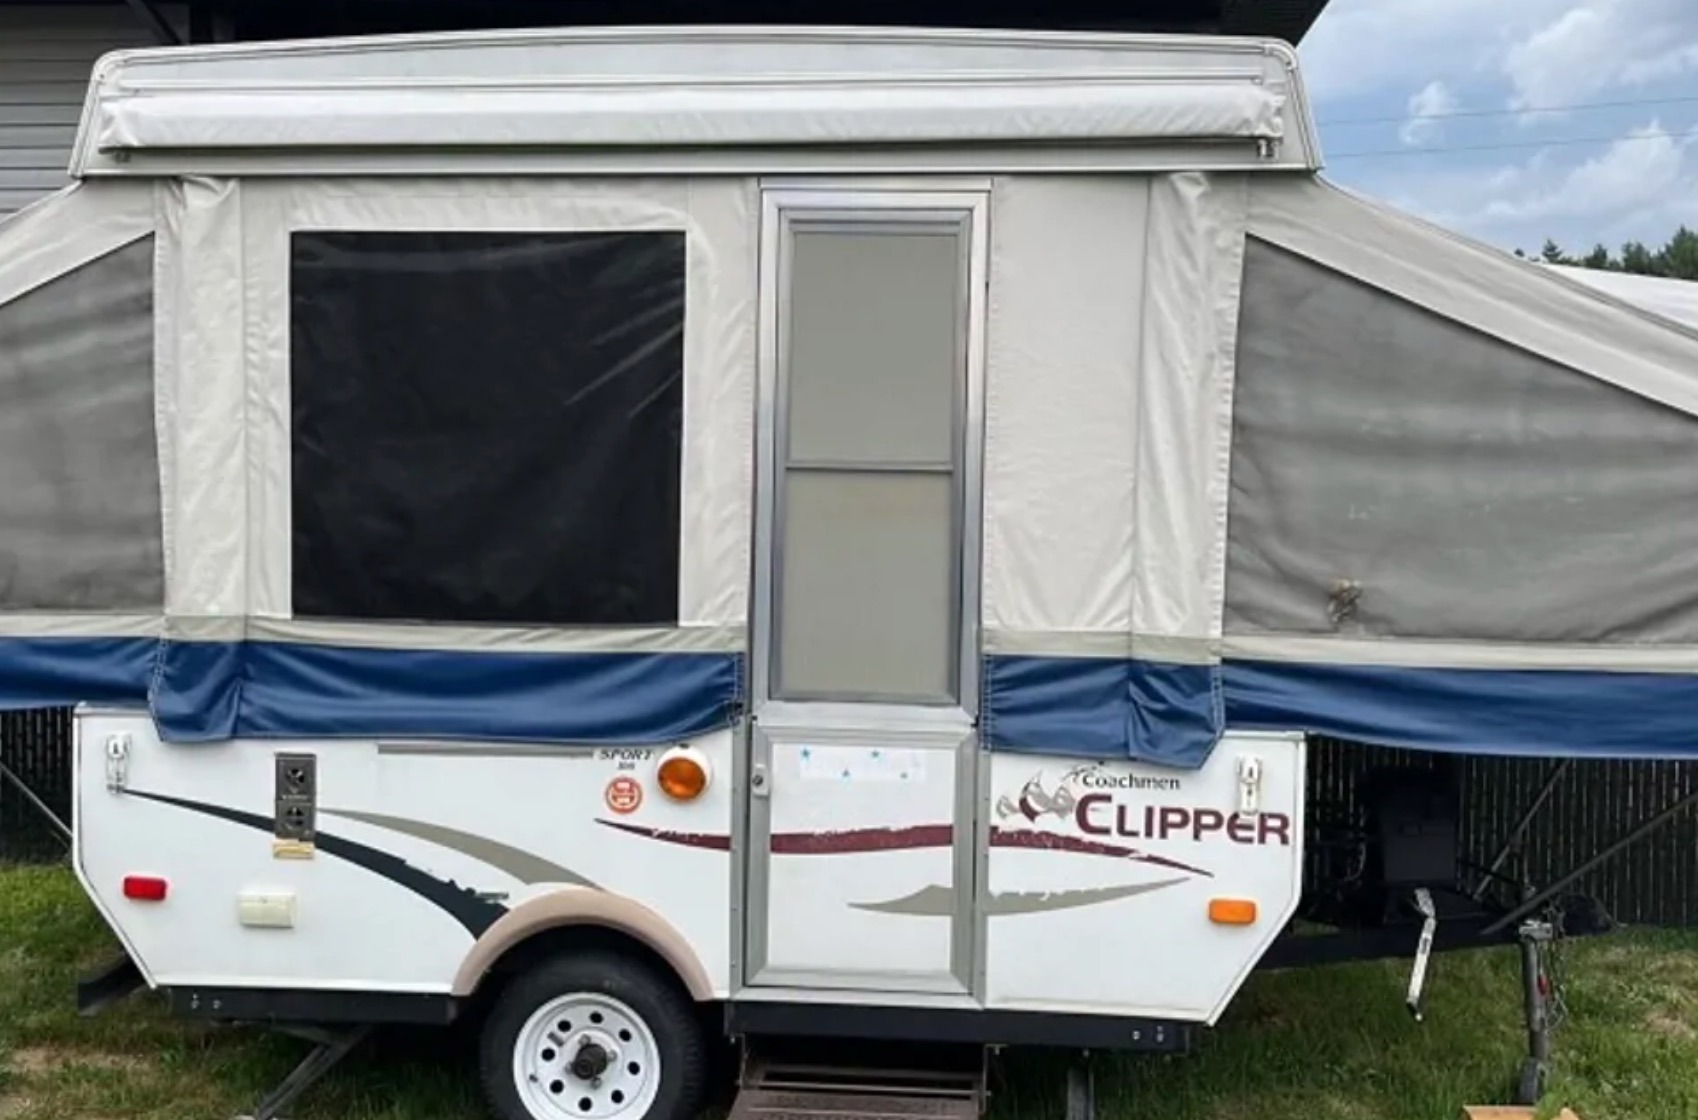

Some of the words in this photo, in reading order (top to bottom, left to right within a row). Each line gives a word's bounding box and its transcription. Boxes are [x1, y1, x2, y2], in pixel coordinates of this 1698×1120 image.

[601, 748, 654, 760] SPORT
[1082, 772, 1181, 790] Coachmen
[1075, 793, 1291, 846] CLIPPER
